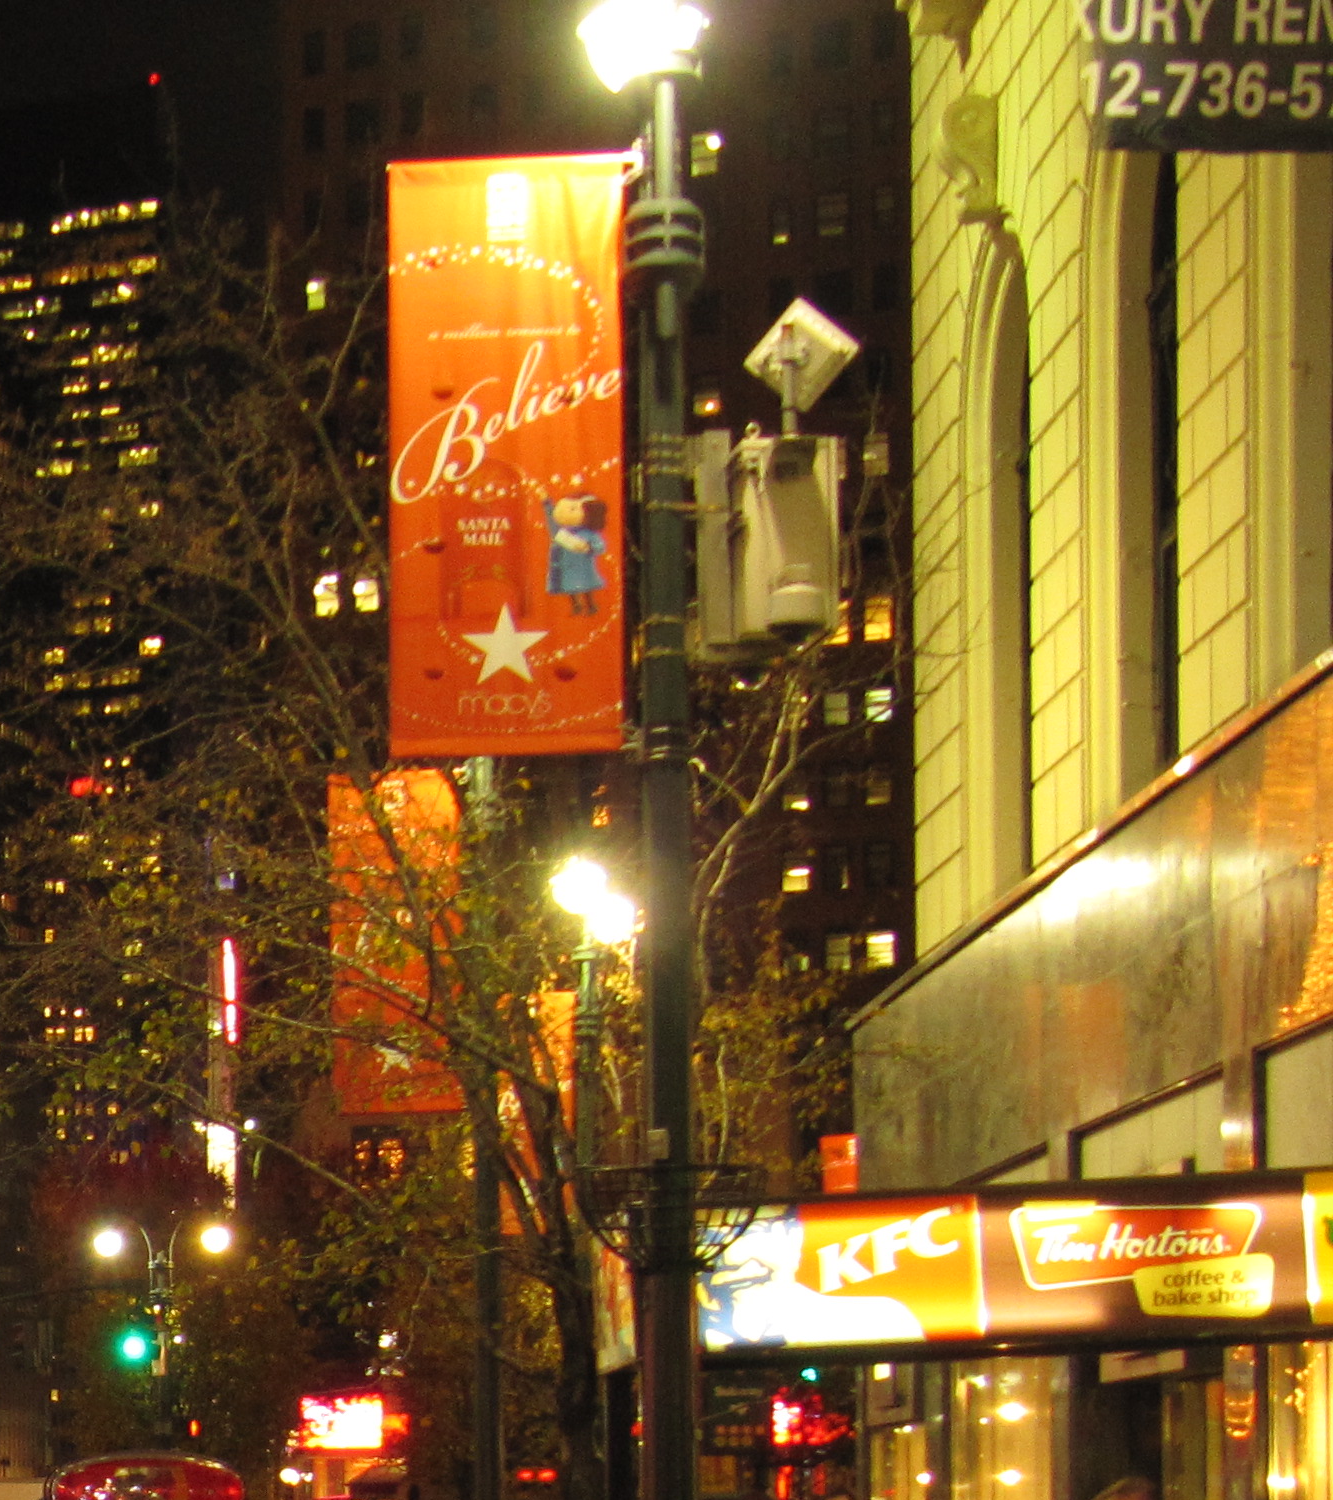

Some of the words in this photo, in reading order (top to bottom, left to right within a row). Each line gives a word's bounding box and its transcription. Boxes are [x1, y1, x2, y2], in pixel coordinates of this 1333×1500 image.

[1081, 60, 1333, 118] 12-736-5
[390, 340, 622, 505] Believe
[457, 517, 511, 531] SANTA
[463, 532, 504, 546] MAIL
[817, 1208, 959, 1294] KFC
[1032, 1224, 1095, 1264] Tim
[1098, 1222, 1225, 1260] Hortons
[1163, 1269, 1225, 1288] coffee
[1153, 1289, 1202, 1307] bake
[1206, 1287, 1257, 1308] shop
